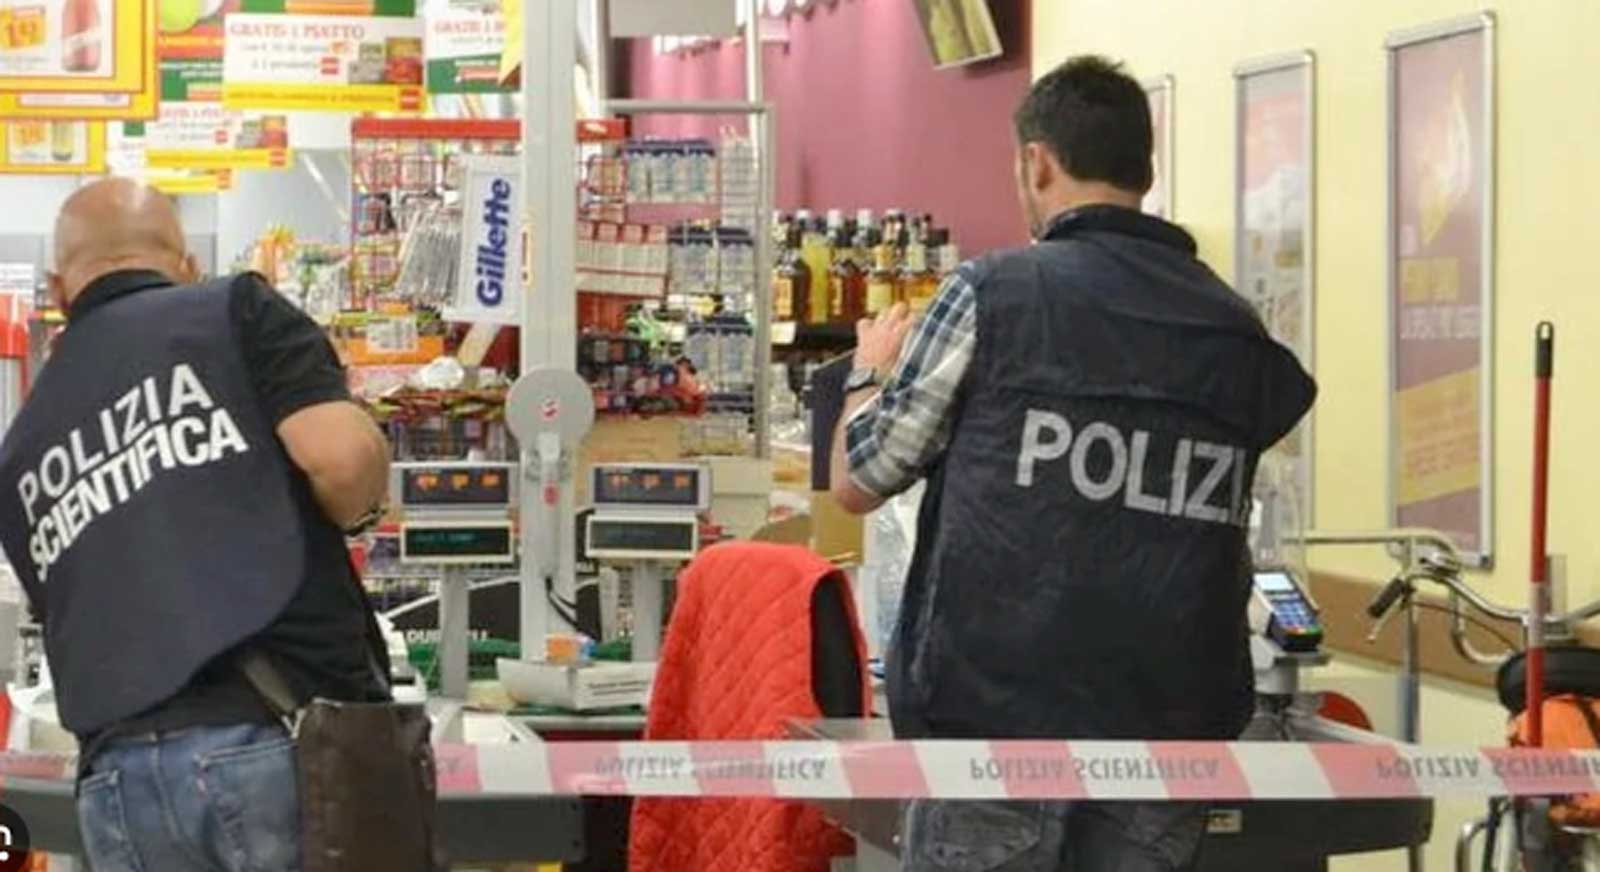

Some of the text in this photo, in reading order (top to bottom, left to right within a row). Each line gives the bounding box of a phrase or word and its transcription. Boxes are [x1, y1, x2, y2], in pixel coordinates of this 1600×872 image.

[476, 178, 511, 307] Gillette
[18, 363, 214, 526] POLIZIA
[29, 407, 249, 582] SCIENTIFICA
[1015, 407, 1248, 527] POLIZI
